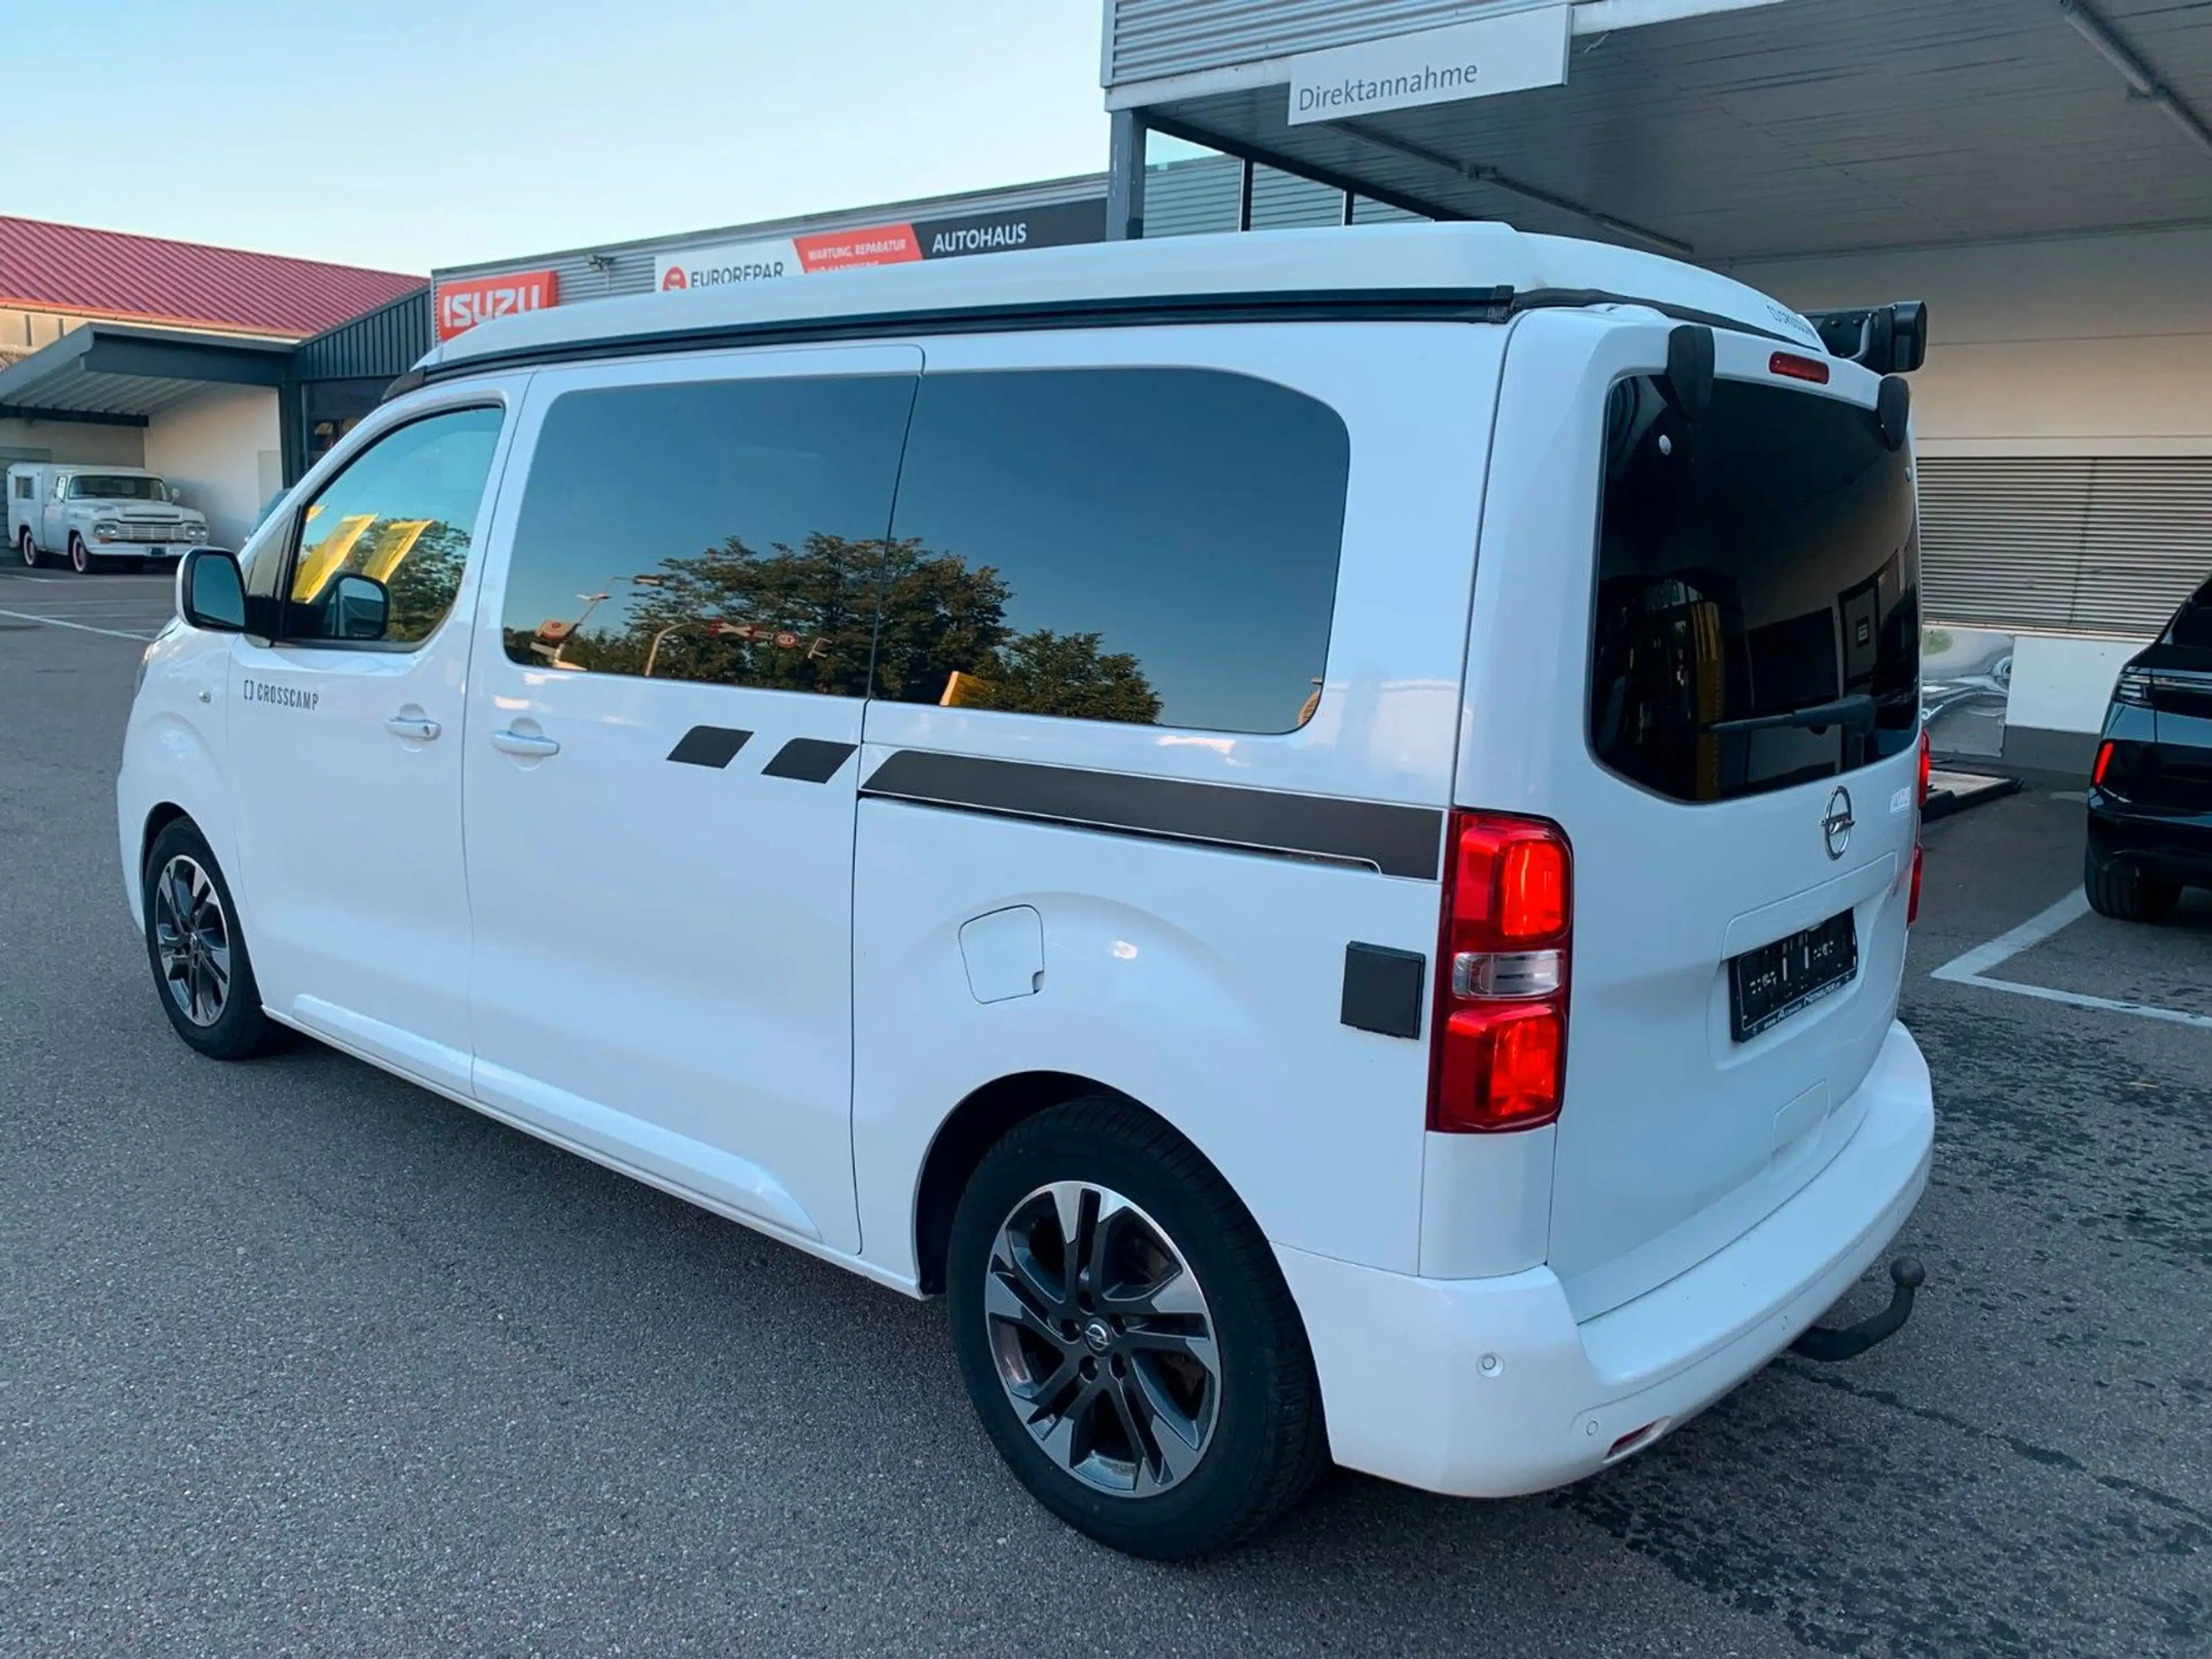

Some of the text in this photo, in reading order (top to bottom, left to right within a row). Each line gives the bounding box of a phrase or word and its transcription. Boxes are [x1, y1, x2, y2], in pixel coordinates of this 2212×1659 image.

[1299, 65, 1478, 111] Direktannahme
[855, 238, 907, 255] REPARATUR
[932, 222, 1027, 253] AUTOHAUS
[444, 285, 540, 328] ISUZU
[257, 683, 319, 711] CROSSCAMP
